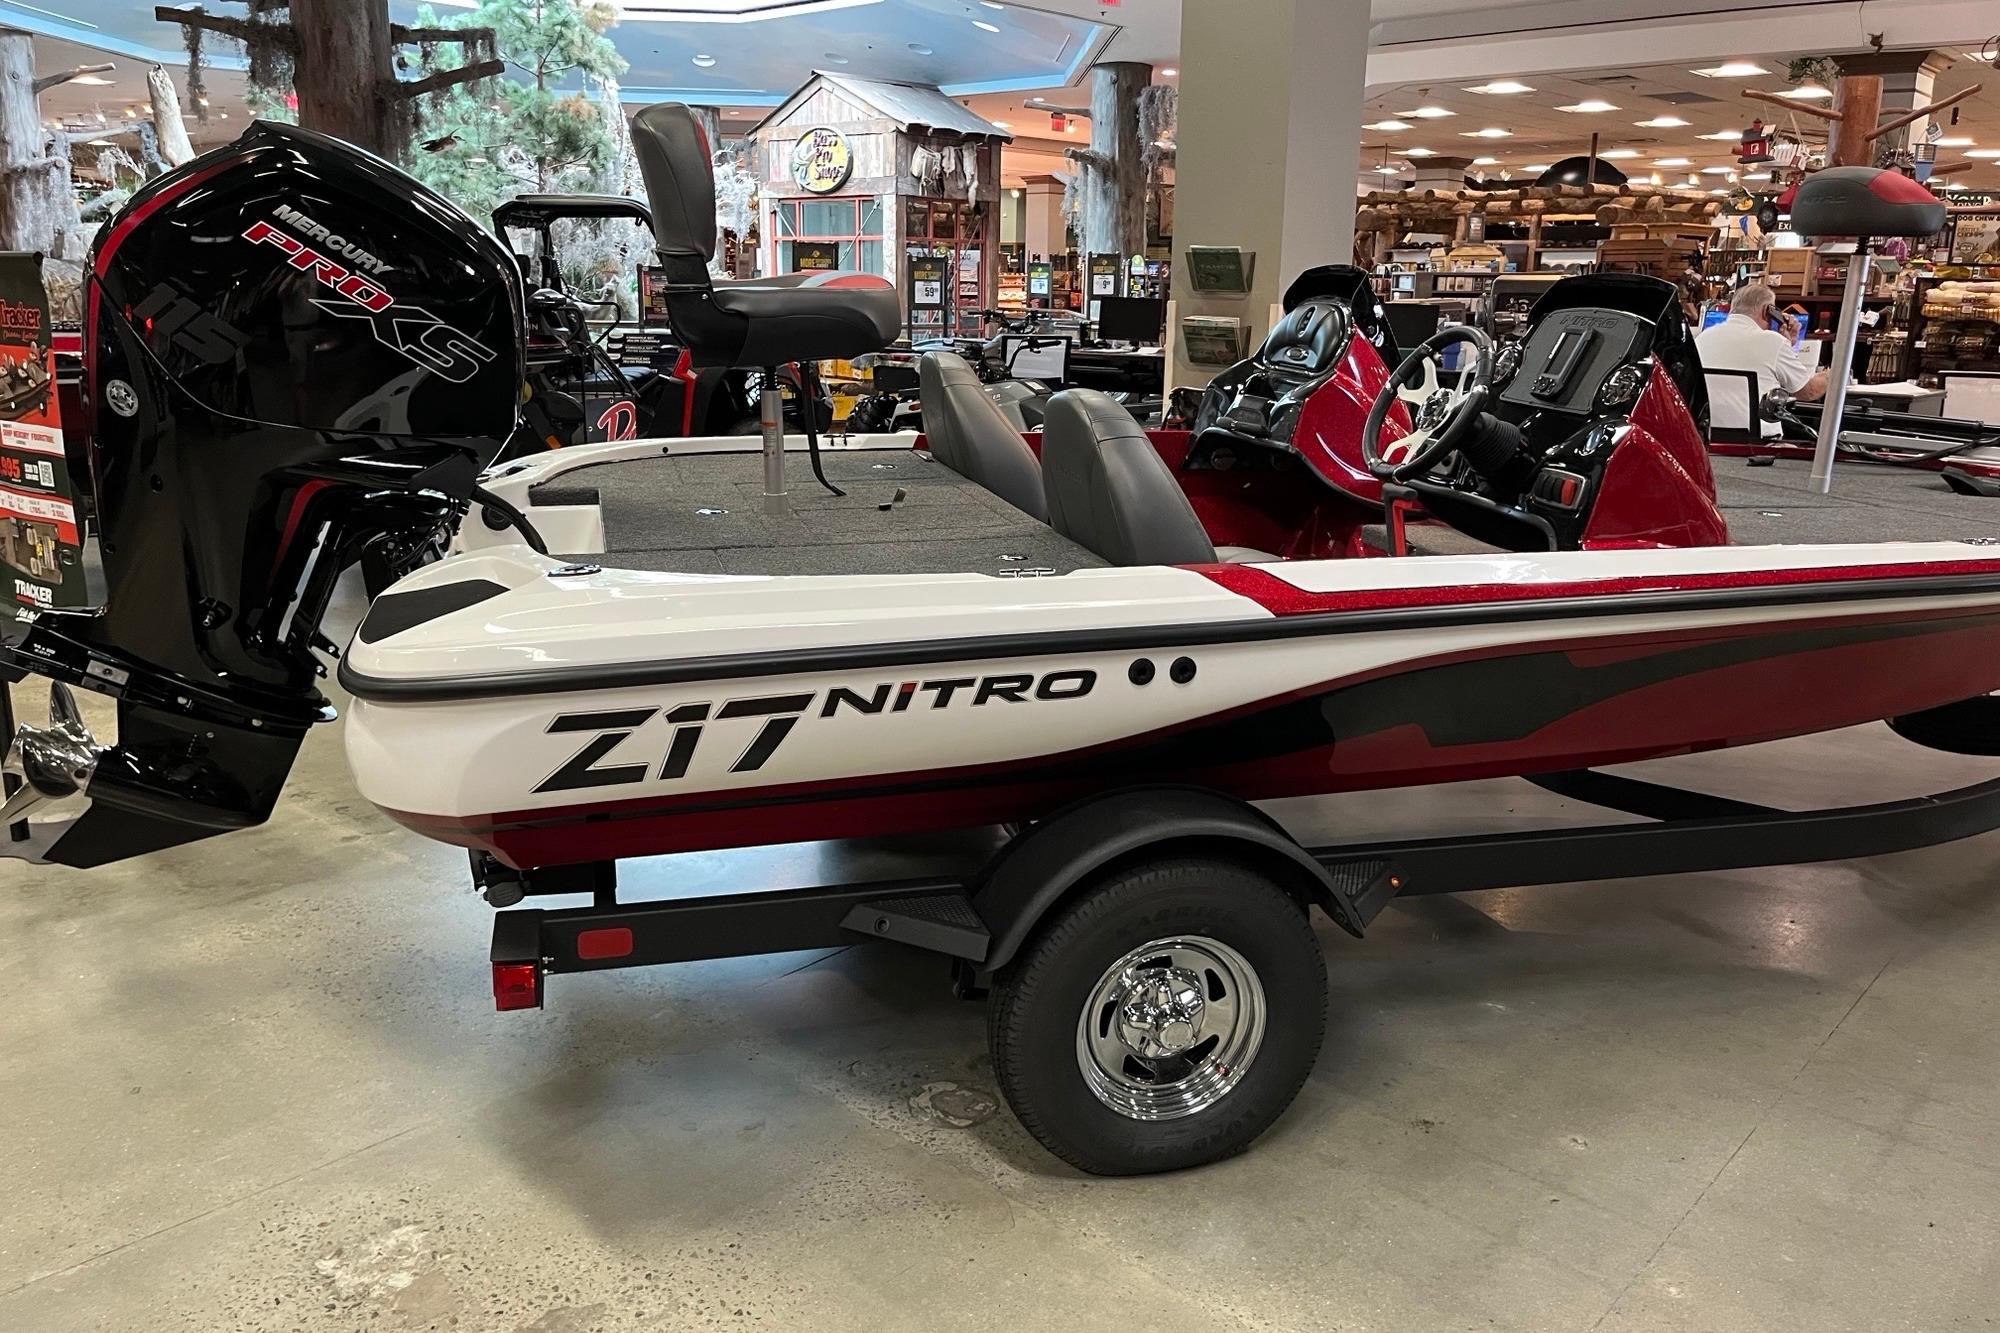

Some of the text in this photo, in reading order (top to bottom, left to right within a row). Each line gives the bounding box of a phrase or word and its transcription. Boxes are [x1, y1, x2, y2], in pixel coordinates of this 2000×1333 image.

[241, 220, 395, 313] PRO
[272, 204, 393, 275] MERCURY
[308, 298, 497, 383] XS
[15, 579, 53, 604] TRACKER
[528, 690, 818, 795] Z17
